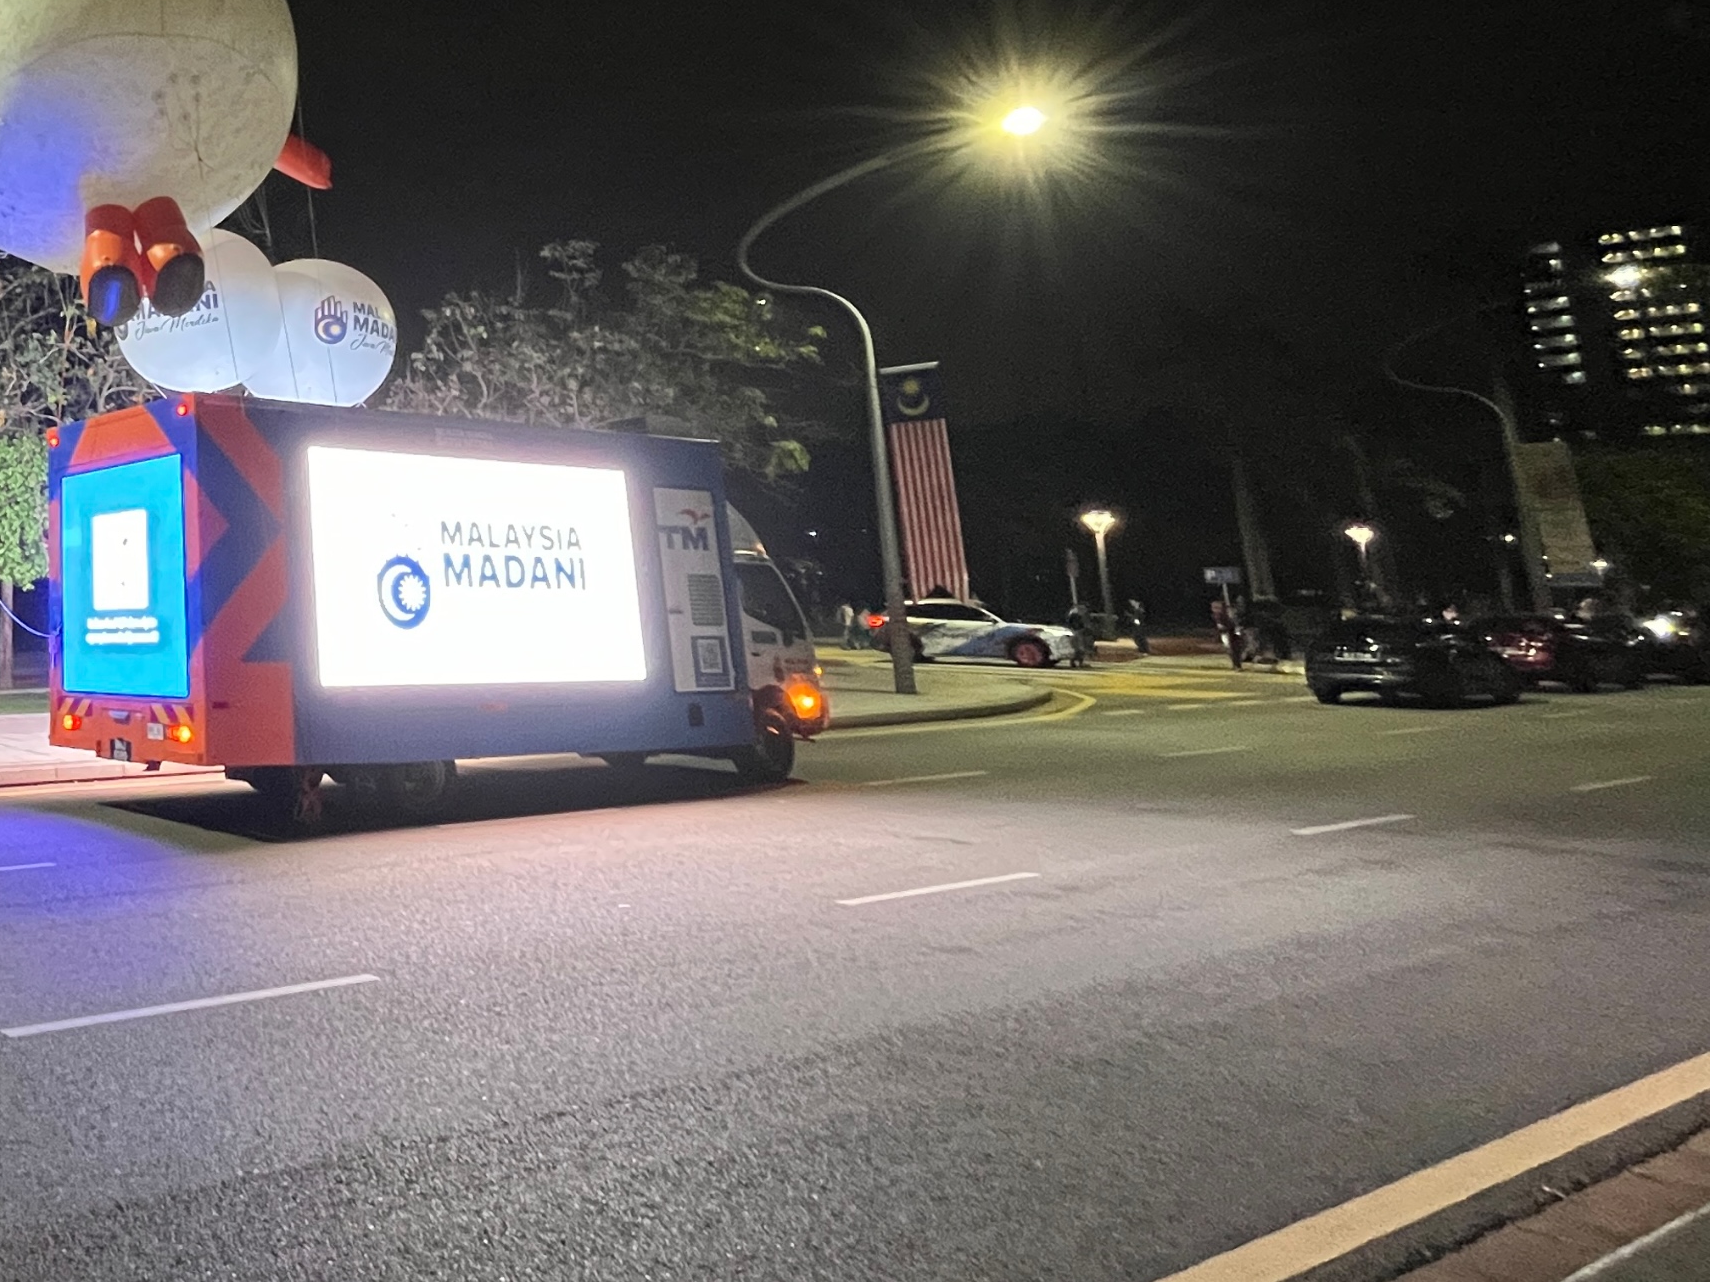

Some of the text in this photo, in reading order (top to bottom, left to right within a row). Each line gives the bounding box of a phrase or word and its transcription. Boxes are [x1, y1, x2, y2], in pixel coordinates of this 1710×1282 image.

[441, 521, 582, 551] MALAYSIA
[656, 524, 710, 552] TM
[443, 552, 586, 591] MADANI
